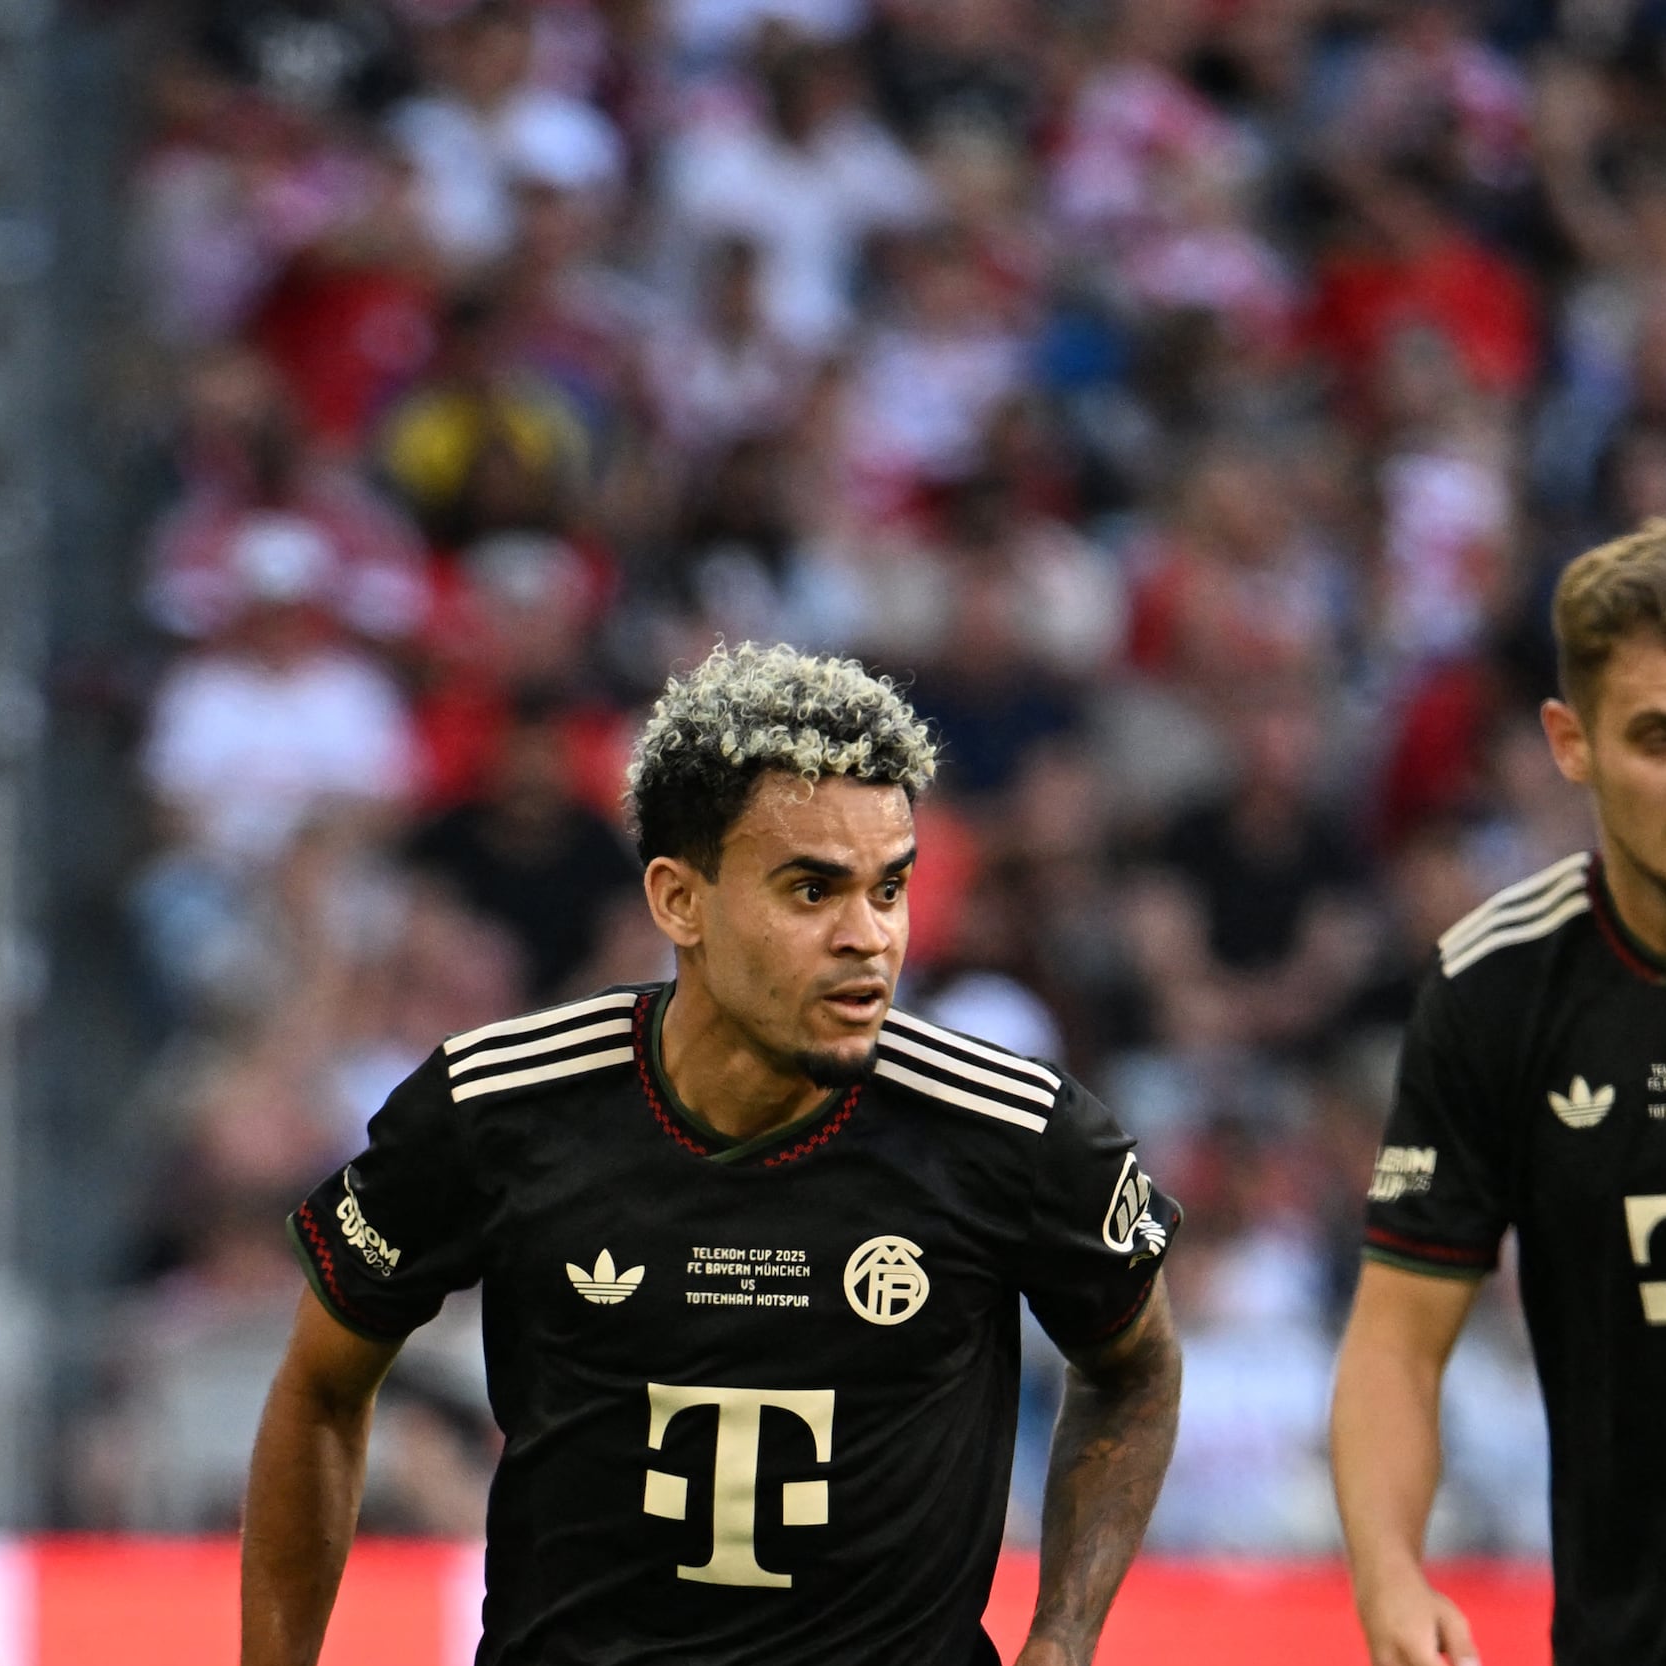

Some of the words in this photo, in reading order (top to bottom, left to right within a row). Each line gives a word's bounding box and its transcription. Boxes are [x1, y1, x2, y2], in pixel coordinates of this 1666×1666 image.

[336, 1196, 366, 1248] CUP
[692, 1247, 746, 1261] TELEKOM
[749, 1249, 772, 1261] CUP
[776, 1250, 806, 1262] 2025
[686, 1262, 703, 1274] FC
[705, 1263, 751, 1276] BAYERN
[755, 1263, 811, 1277] MÜNCHEN
[740, 1279, 756, 1291] VS
[685, 1291, 753, 1306] TOTTENHAM
[757, 1295, 810, 1307] HOTSPUR
[643, 1383, 836, 1588] T
